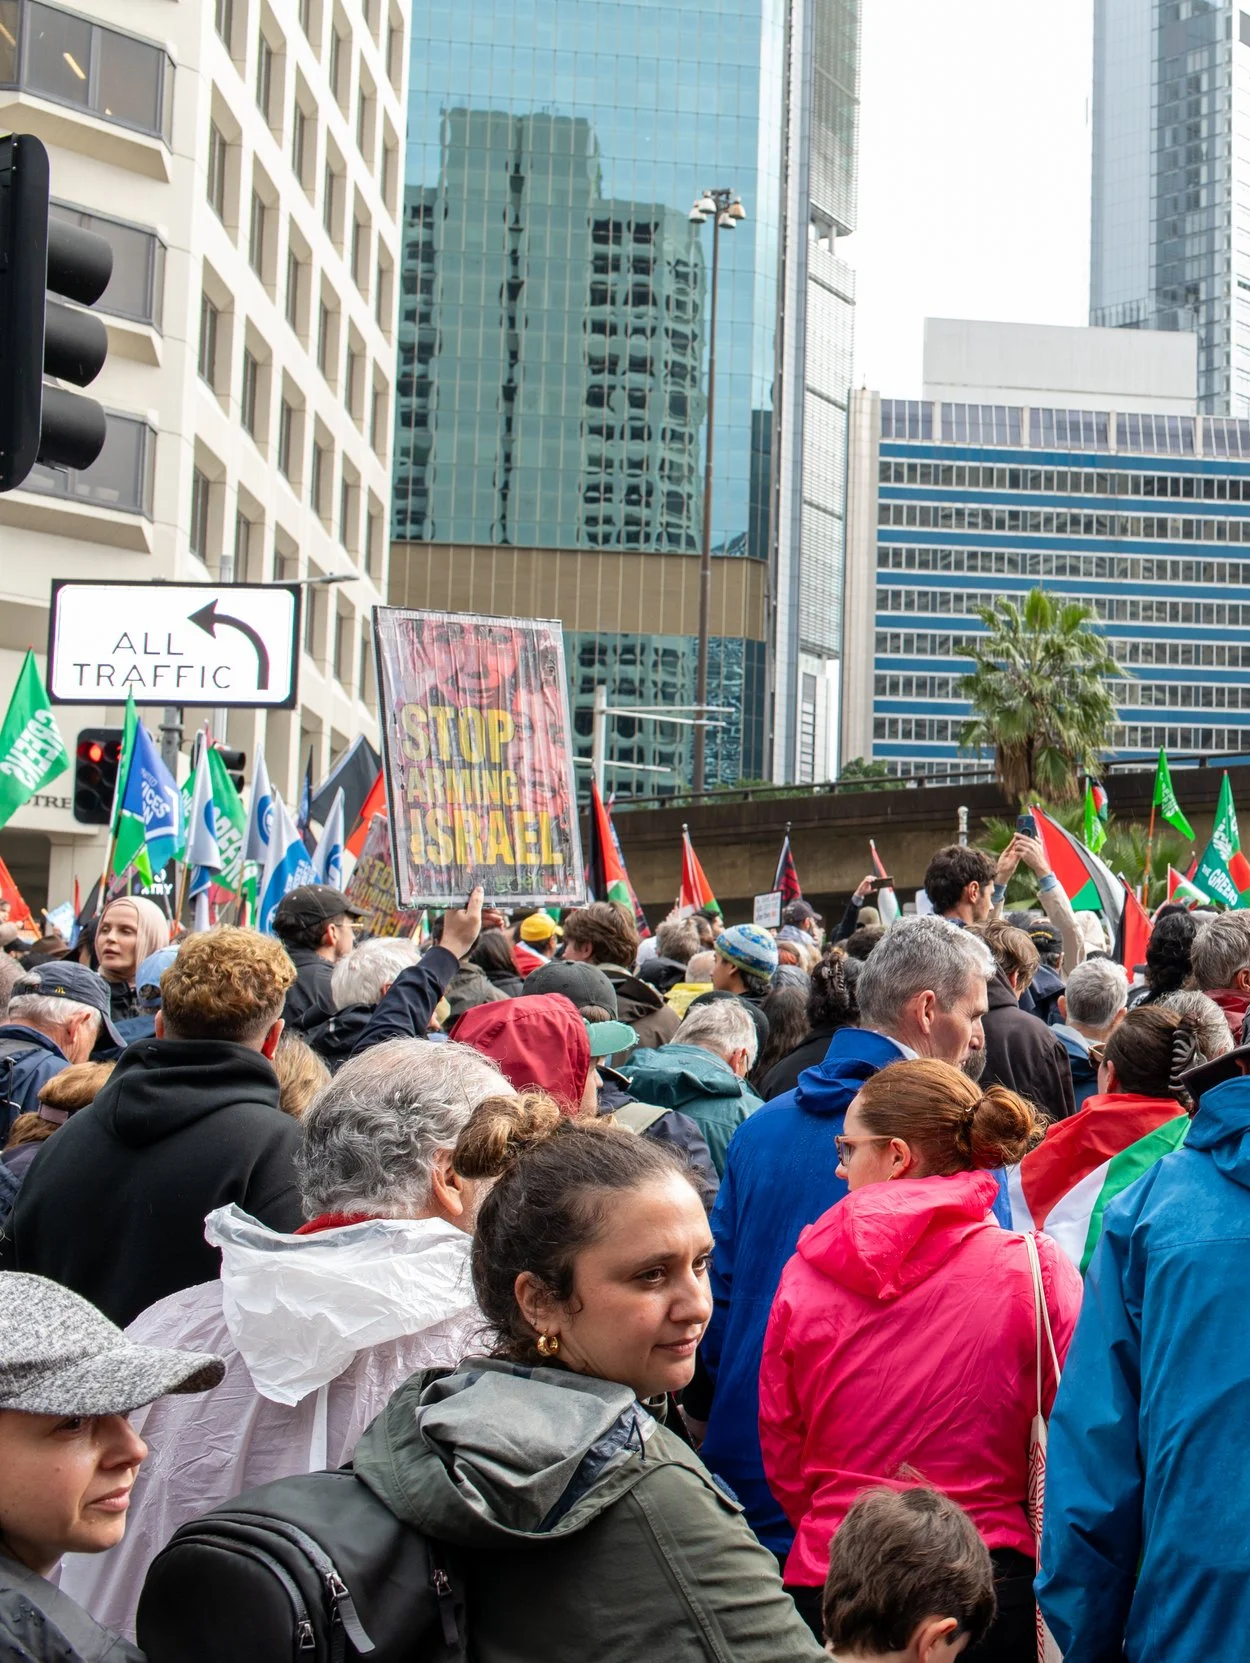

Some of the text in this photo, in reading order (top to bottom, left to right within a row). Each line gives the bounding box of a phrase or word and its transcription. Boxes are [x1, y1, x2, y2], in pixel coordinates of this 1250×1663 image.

[112, 631, 185, 656] ALL
[72, 662, 232, 690] TRAFFIC
[401, 702, 516, 764] STOP
[23, 794, 72, 811] TRE
[406, 767, 519, 806] ARMING
[409, 808, 565, 866] ISRAEL
[356, 855, 396, 893] STO
[1207, 868, 1239, 906] GREENS
